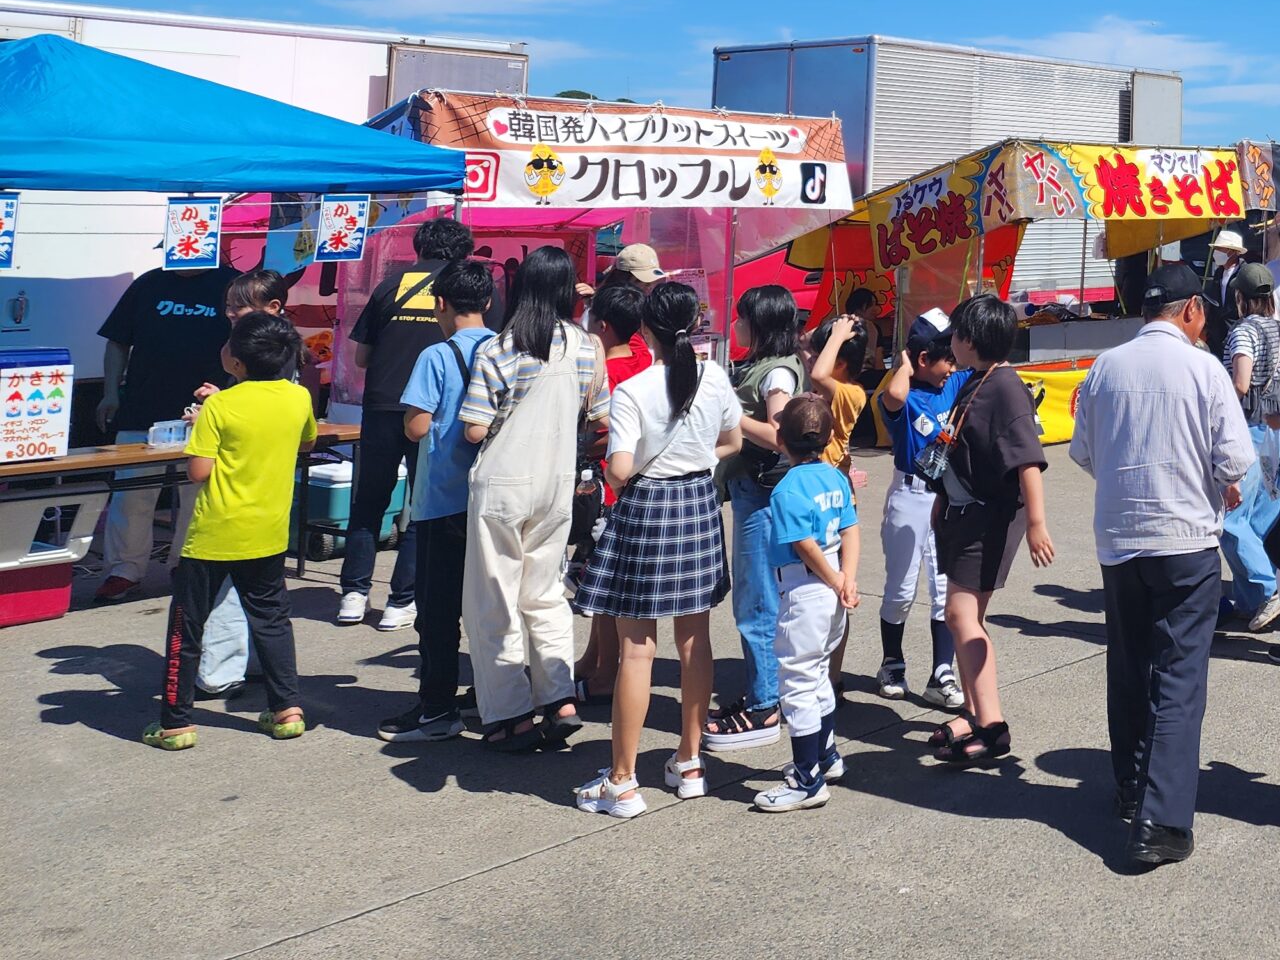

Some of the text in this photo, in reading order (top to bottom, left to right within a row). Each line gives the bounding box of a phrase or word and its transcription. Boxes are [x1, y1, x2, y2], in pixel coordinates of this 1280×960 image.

[507, 111, 790, 148] 韓国発ハイブリットスイーツ
[570, 154, 751, 202] クロッフル
[1023, 151, 1077, 217] ヤバい
[1093, 152, 1241, 218] 焼きそば
[177, 206, 209, 257] かき氷
[329, 203, 358, 250] かき氷
[156, 300, 217, 317] クロッフル
[8, 369, 65, 388] かき氷
